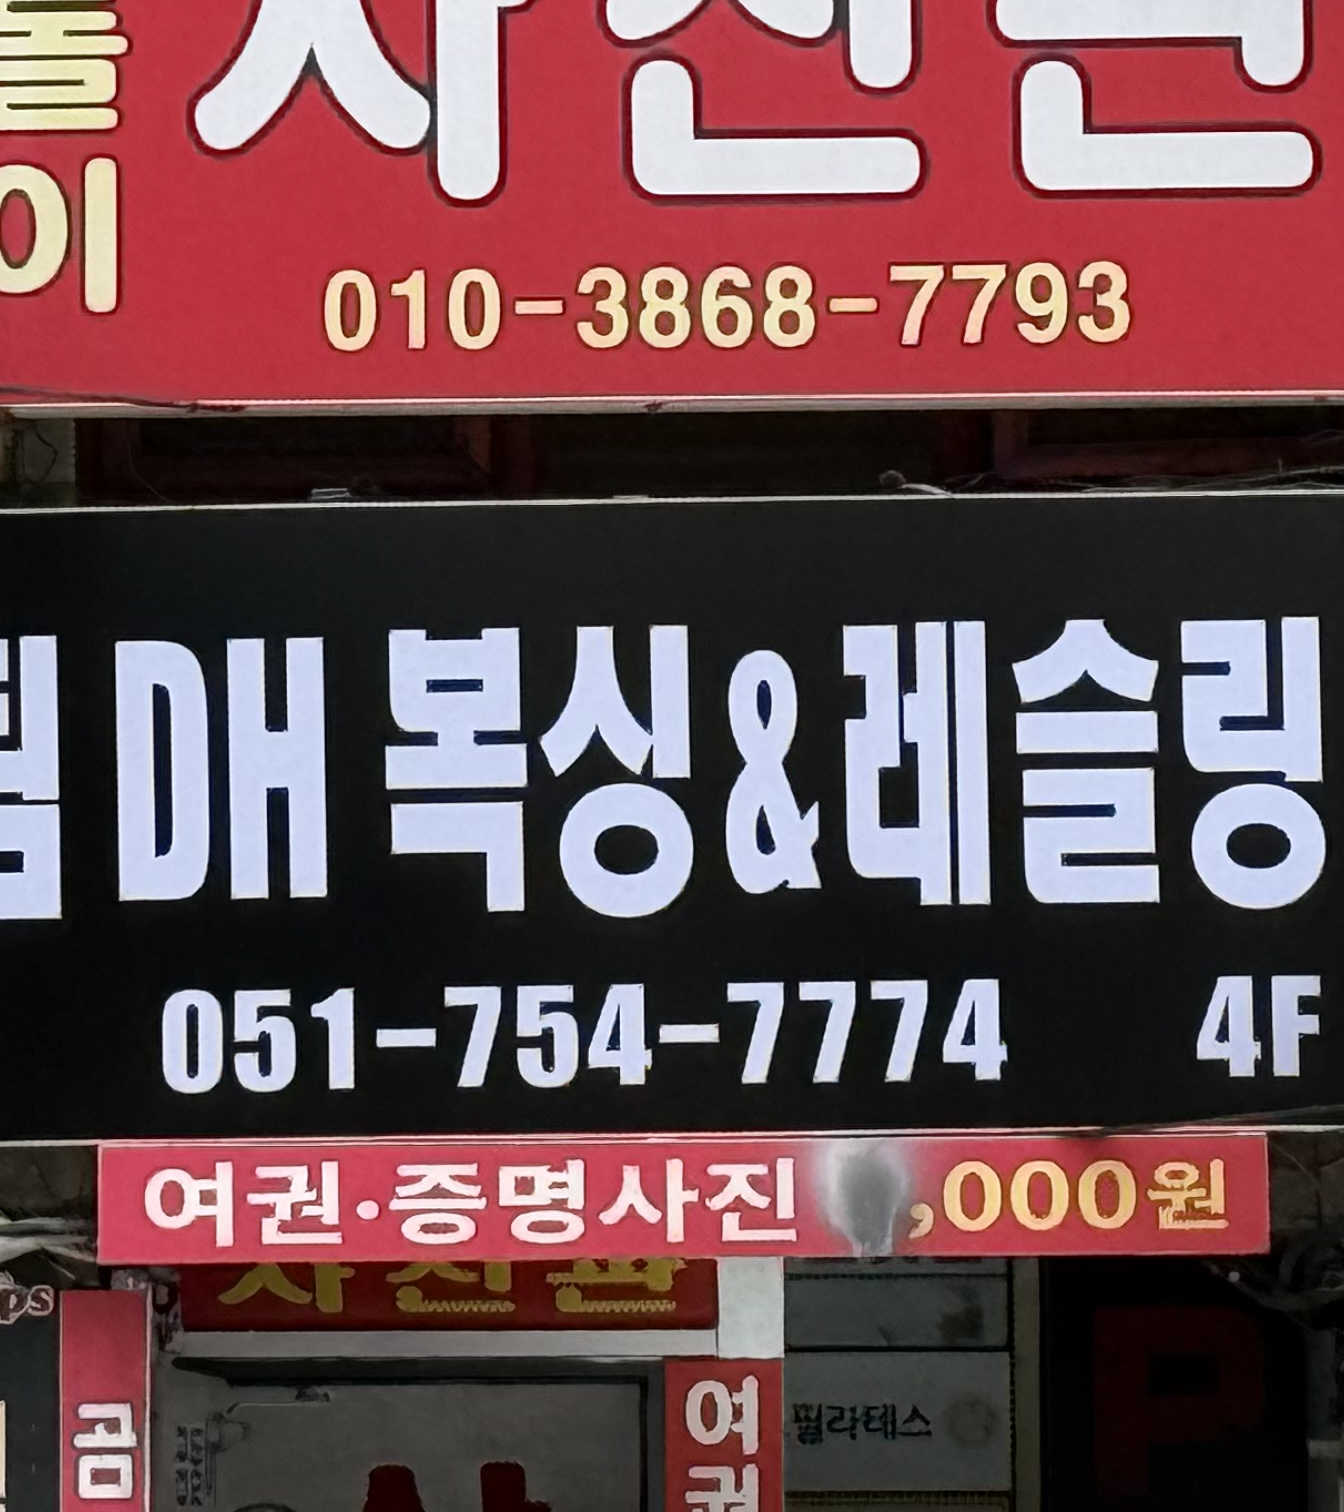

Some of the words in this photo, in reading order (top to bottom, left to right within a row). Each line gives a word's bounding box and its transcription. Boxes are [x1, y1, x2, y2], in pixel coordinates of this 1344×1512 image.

[323, 260, 1133, 352] 010-3868-7793
[385, 615, 1327, 920] 복싱&레슬링
[161, 978, 1008, 1094] 051-754-7774
[1196, 974, 1321, 1078] 4F
[896, 1157, 1231, 1242] ,000원
